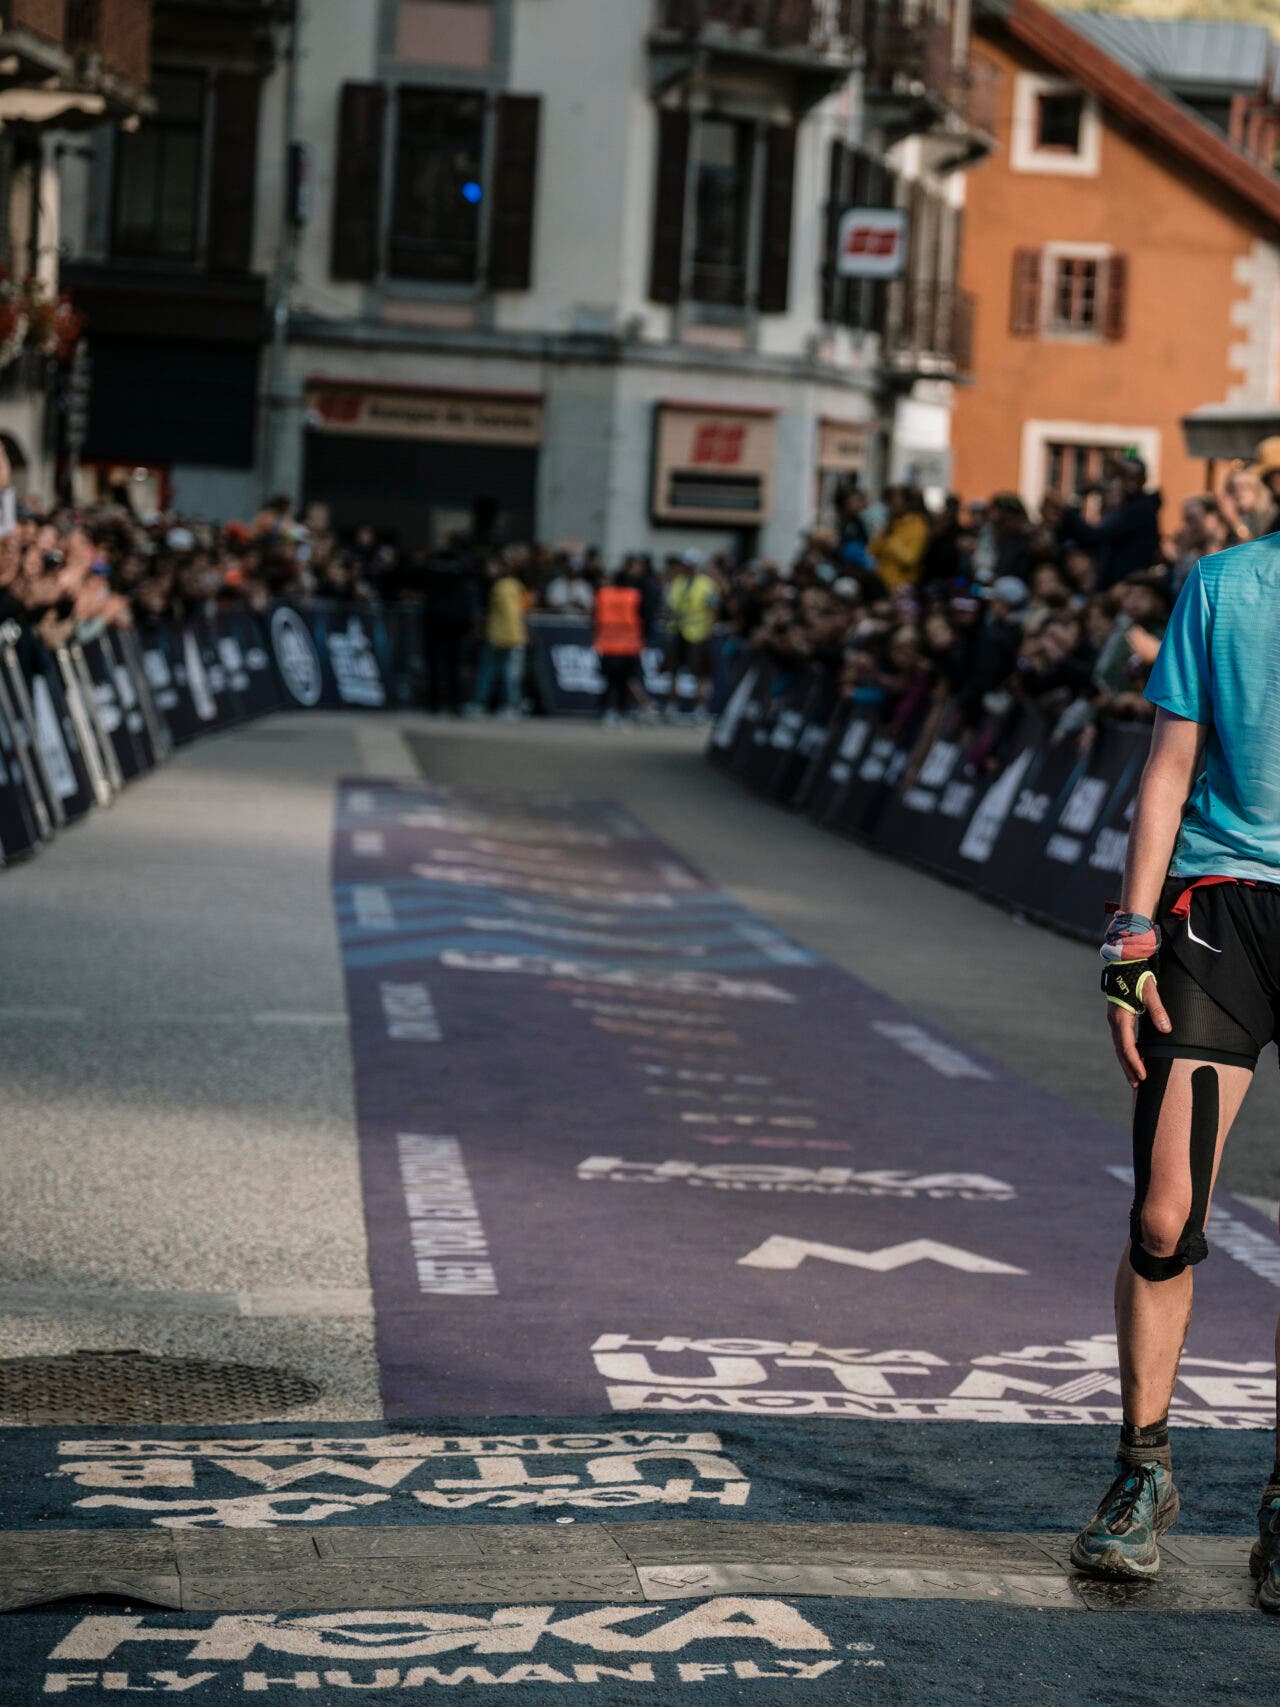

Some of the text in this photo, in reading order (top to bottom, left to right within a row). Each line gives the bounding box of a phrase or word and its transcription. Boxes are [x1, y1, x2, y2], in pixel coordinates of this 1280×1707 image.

[1116, 975, 1130, 996] LEKI
[576, 1155, 1016, 1193] HOKA
[590, 1333, 951, 1366] HOKA
[58, 1450, 749, 1490] UTMB
[411, 1478, 751, 1509] HOKA
[47, 1597, 834, 1660] HOKA
[43, 1659, 844, 1694] FLY HUMAN FLY
